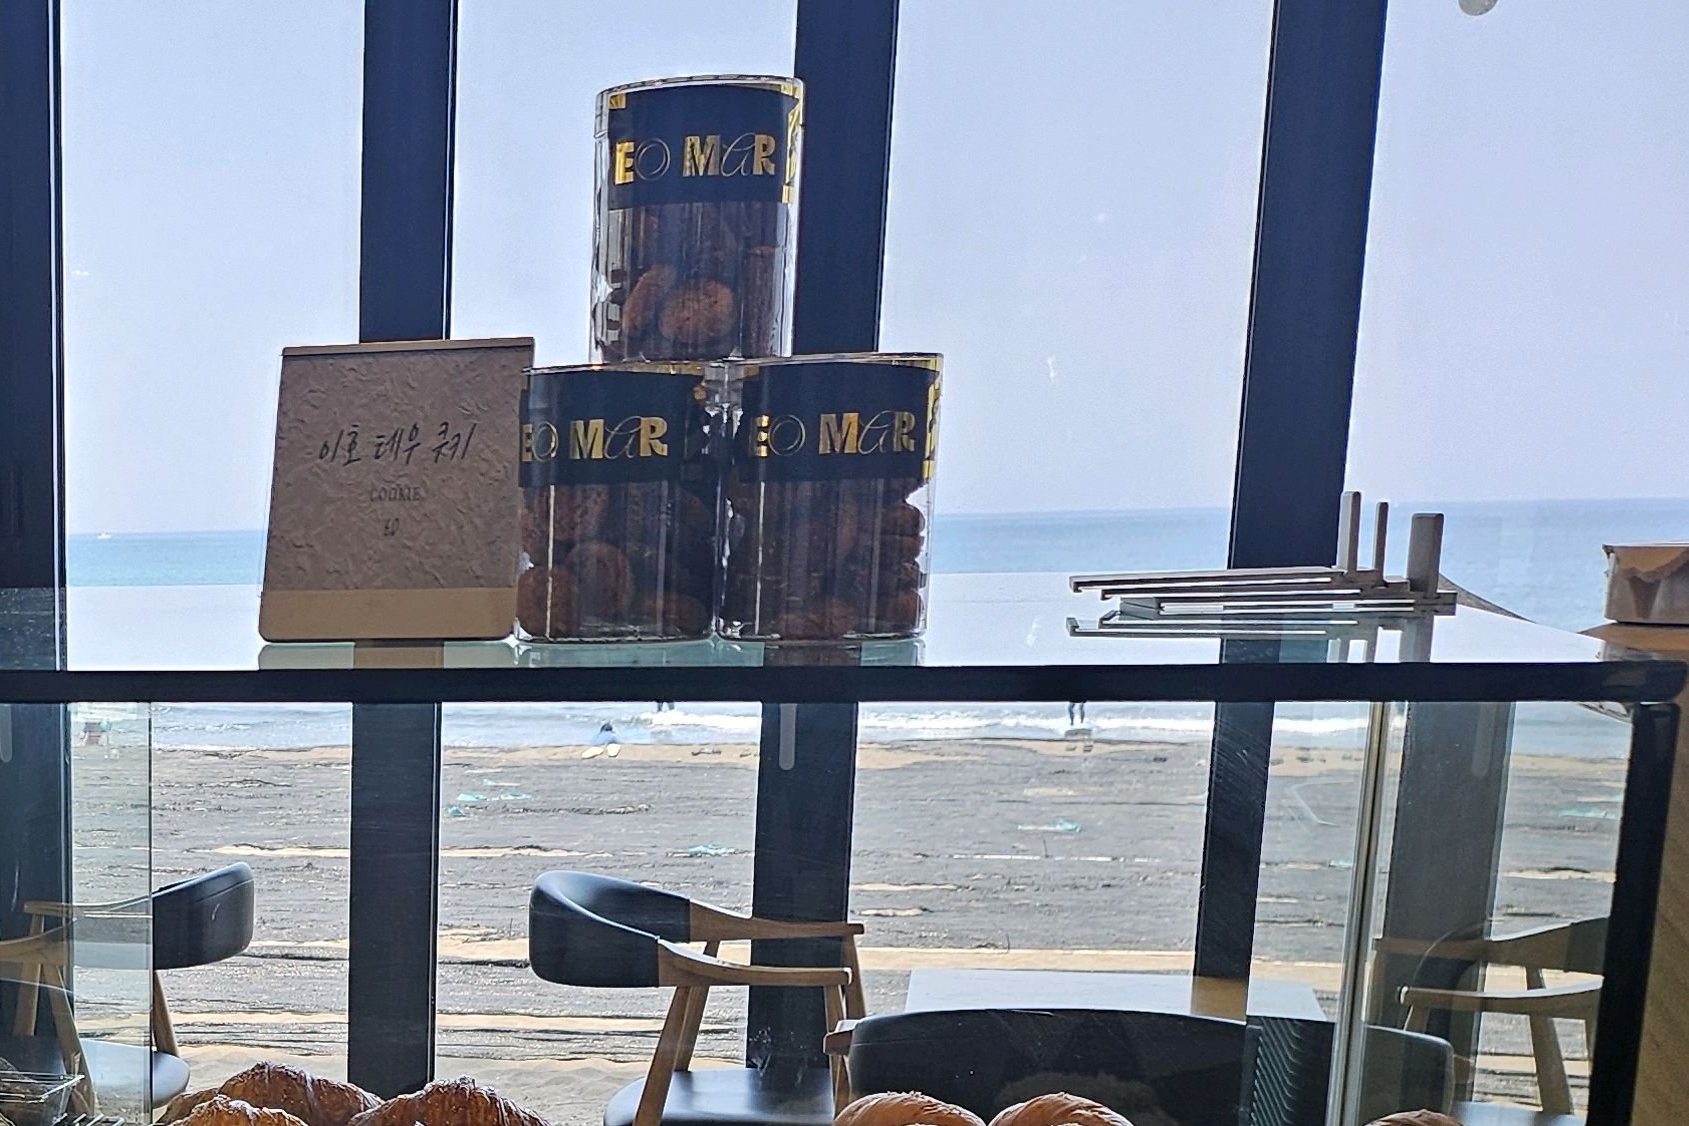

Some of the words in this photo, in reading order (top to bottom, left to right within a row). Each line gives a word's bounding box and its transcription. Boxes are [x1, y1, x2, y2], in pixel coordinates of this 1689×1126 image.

[318, 425, 362, 466] 이호
[373, 421, 421, 465] 테우
[431, 421, 477, 463] 쿠키
[369, 486, 423, 502] COOKIE
